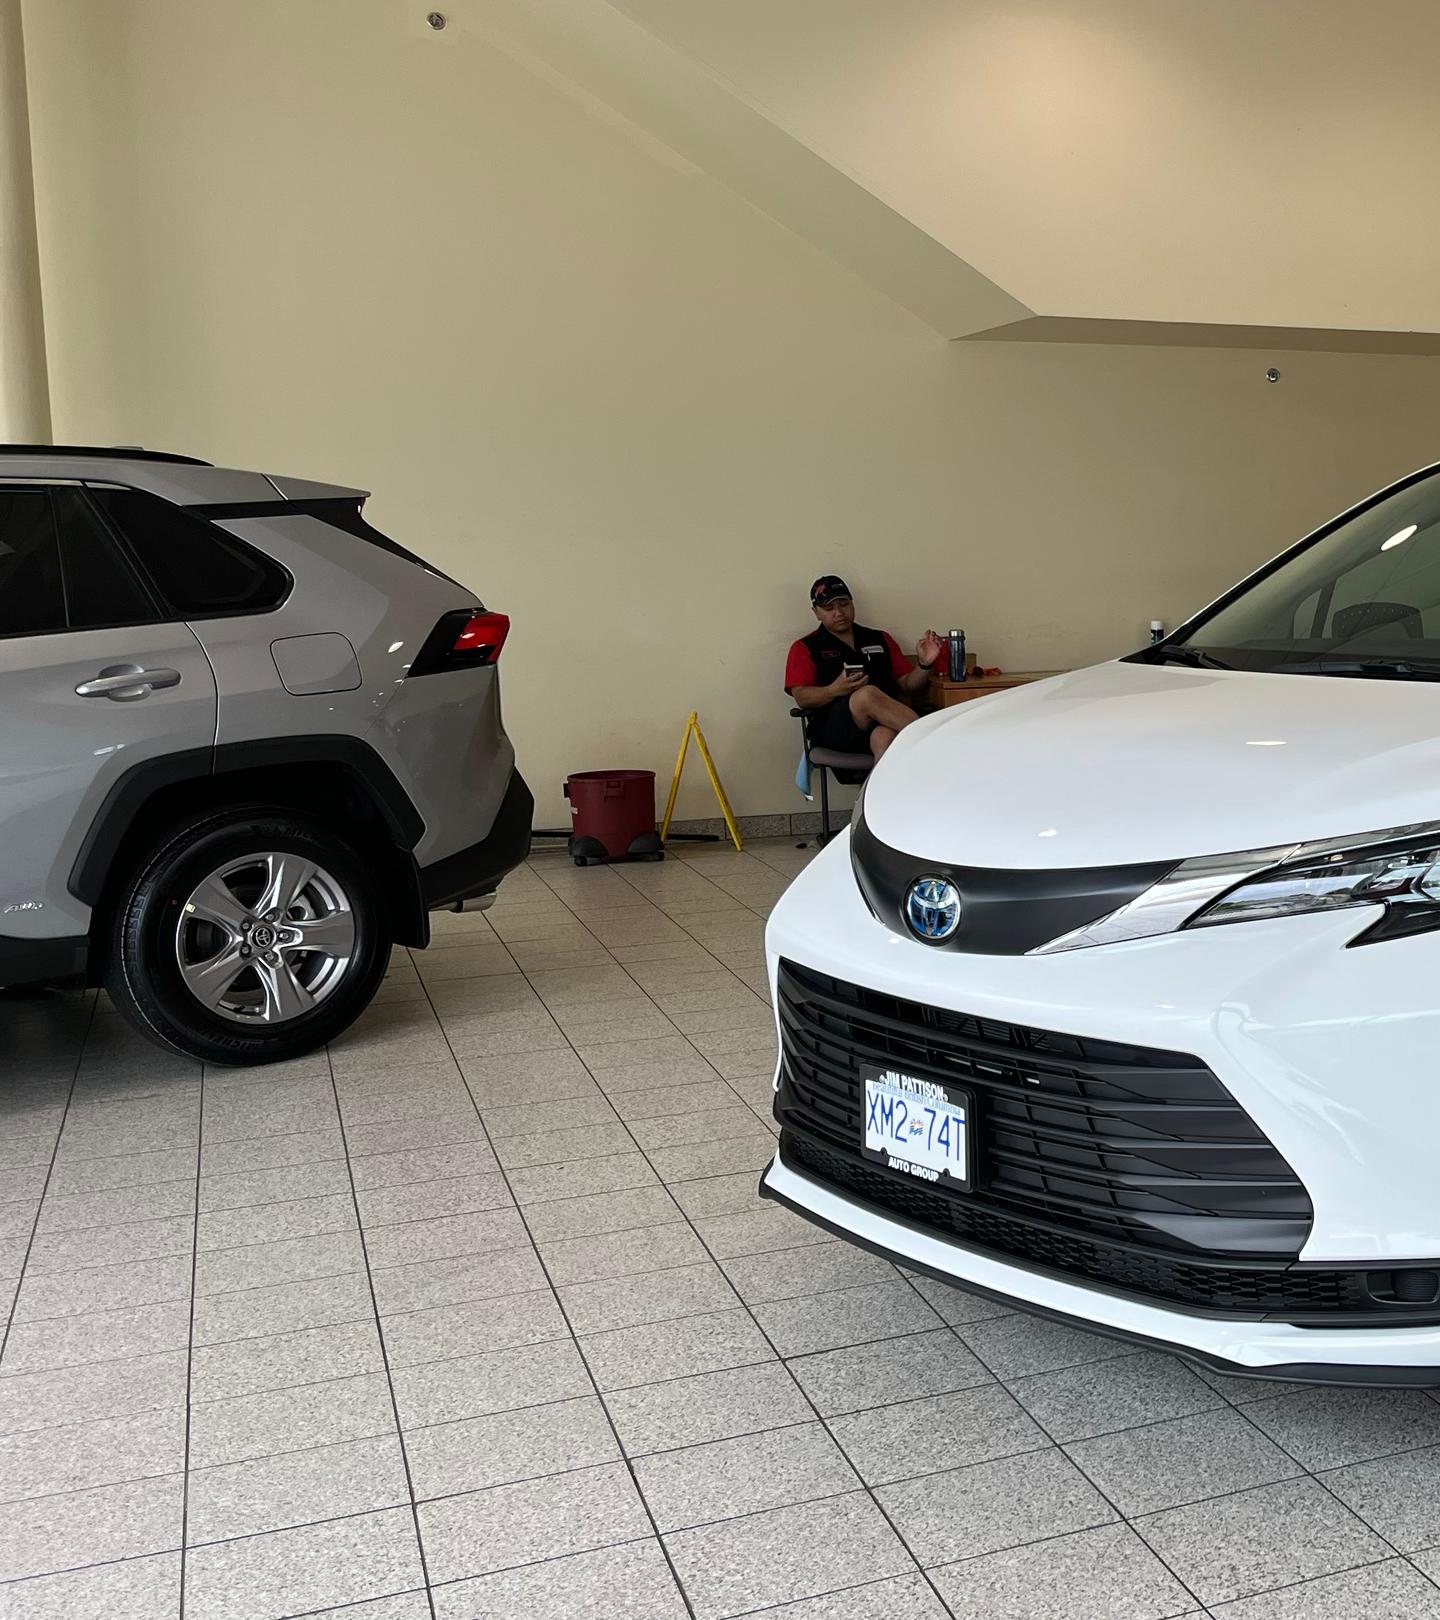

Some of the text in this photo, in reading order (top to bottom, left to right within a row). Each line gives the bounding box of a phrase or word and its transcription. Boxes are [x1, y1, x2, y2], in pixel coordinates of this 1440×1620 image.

[886, 1071, 944, 1100] JIM PATTISON
[867, 1089, 966, 1161] XM2 74T
[888, 1157, 939, 1182] AUTO GROUP
